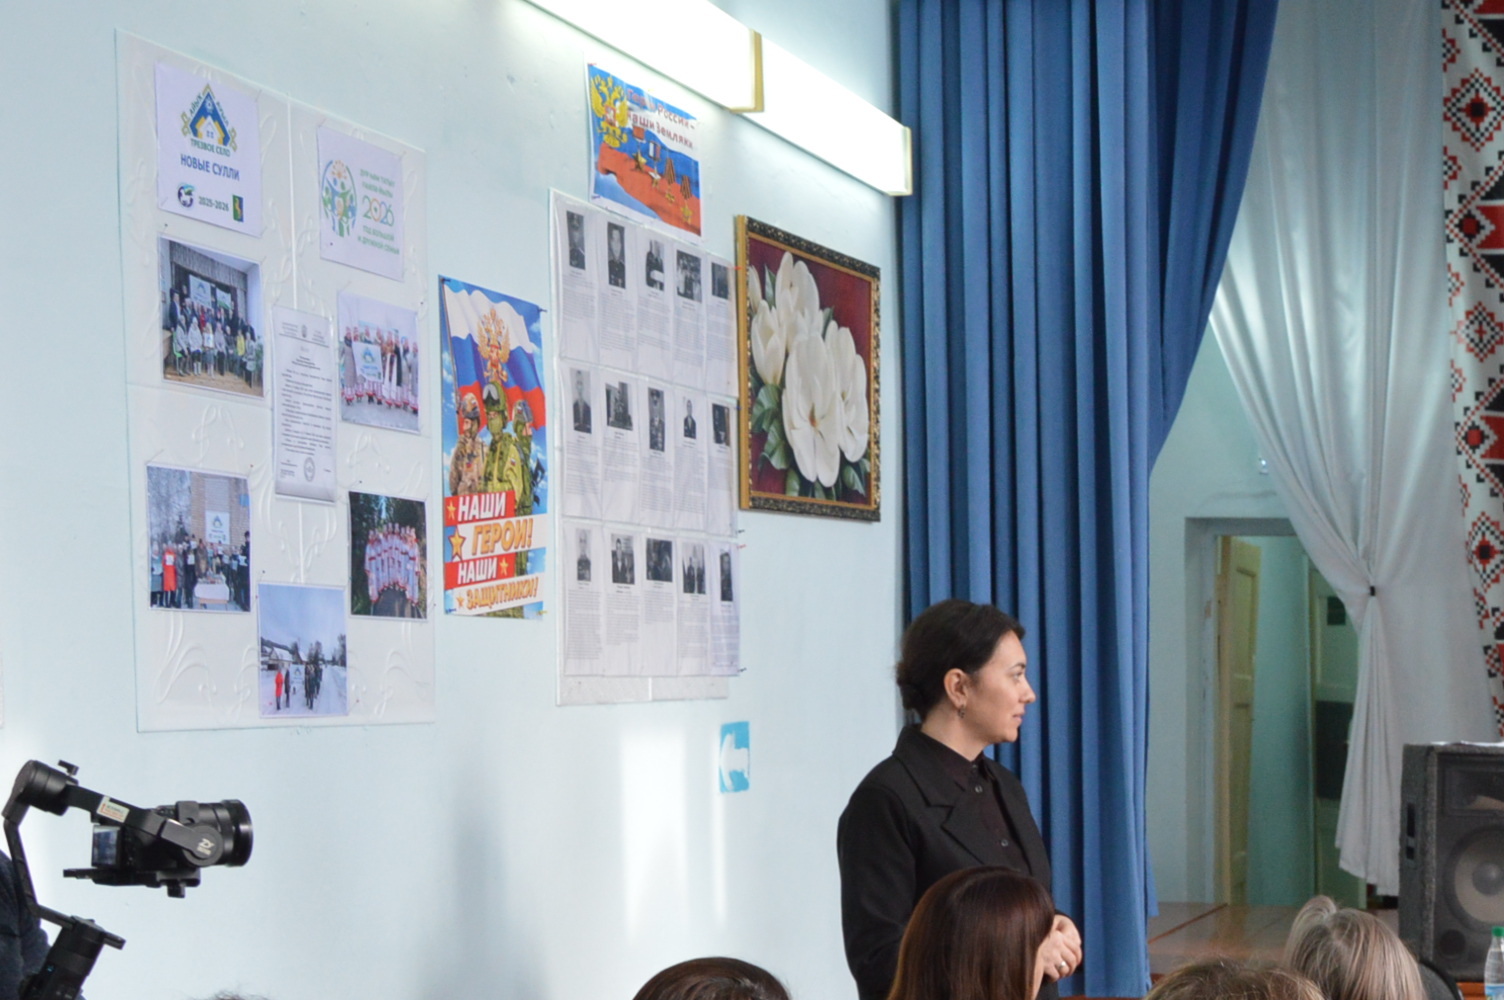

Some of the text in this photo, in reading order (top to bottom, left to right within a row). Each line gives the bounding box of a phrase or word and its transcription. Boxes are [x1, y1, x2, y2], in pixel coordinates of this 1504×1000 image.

[180, 154, 240, 181] НОВЫЕ СУЛЛИ
[198, 196, 229, 212] 2025-2026
[362, 195, 394, 227] 2026
[457, 491, 507, 522] НАШИ
[471, 517, 534, 556] ГЕРОИ!
[457, 557, 498, 585] НАШИ
[466, 576, 539, 610] ЗАЩИТНИКИ!
